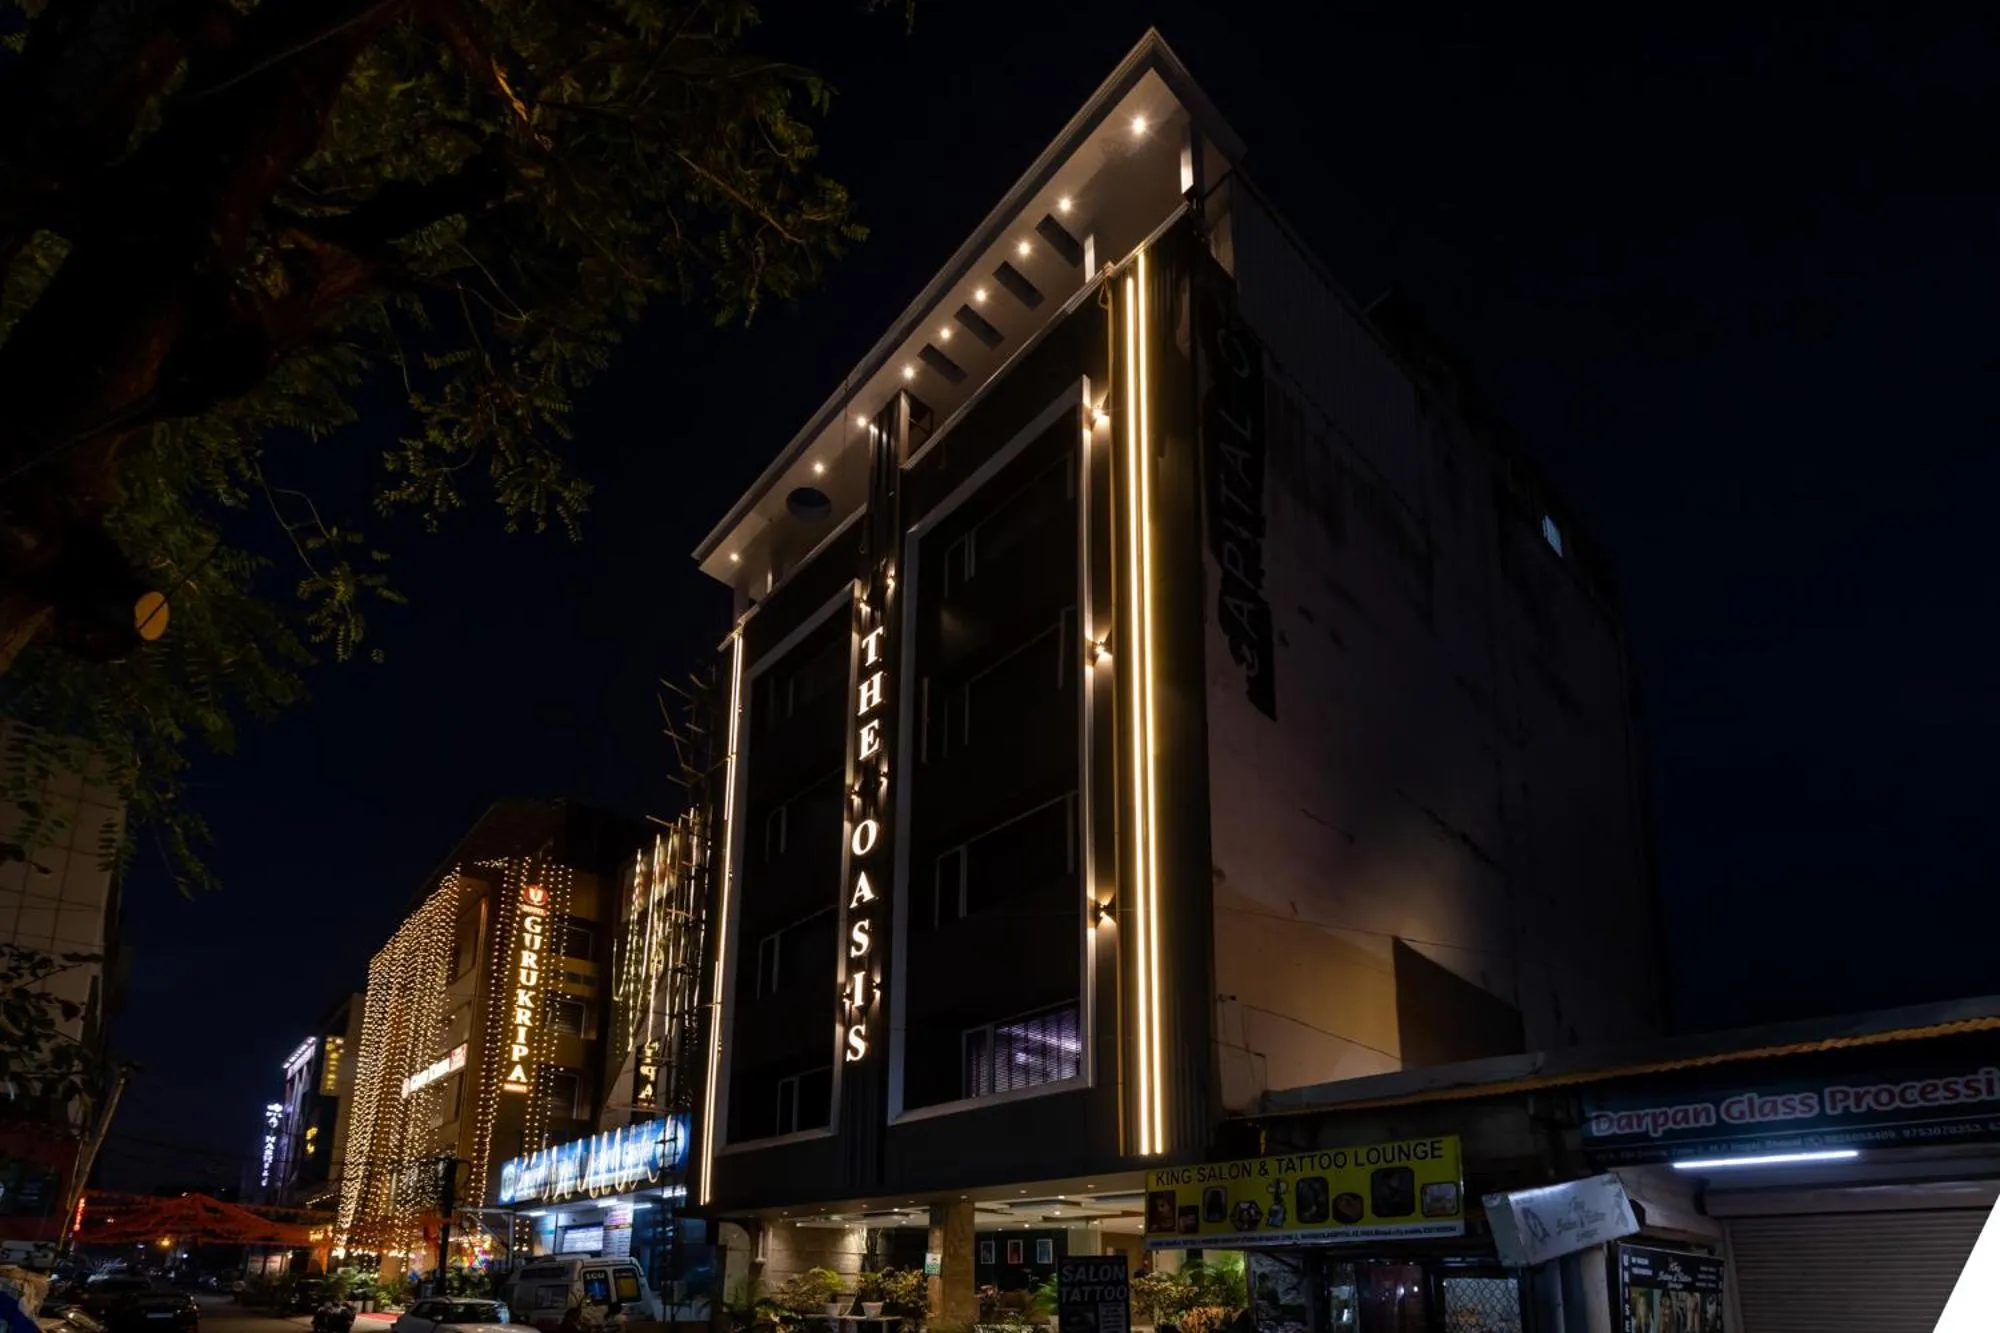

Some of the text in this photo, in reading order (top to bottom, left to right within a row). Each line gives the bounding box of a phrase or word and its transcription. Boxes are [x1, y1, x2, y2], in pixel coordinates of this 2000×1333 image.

[846, 627, 882, 1062] THE OASIS
[507, 917, 542, 1083] GURUKRIPA
[1591, 1067, 2000, 1138] Darpan Glass Processi
[1156, 1140, 1443, 1186] KING SALON & TATTOO LOUNGE
[1060, 1284, 1127, 1304] TATTOO
[1061, 1264, 1126, 1284] SALON
